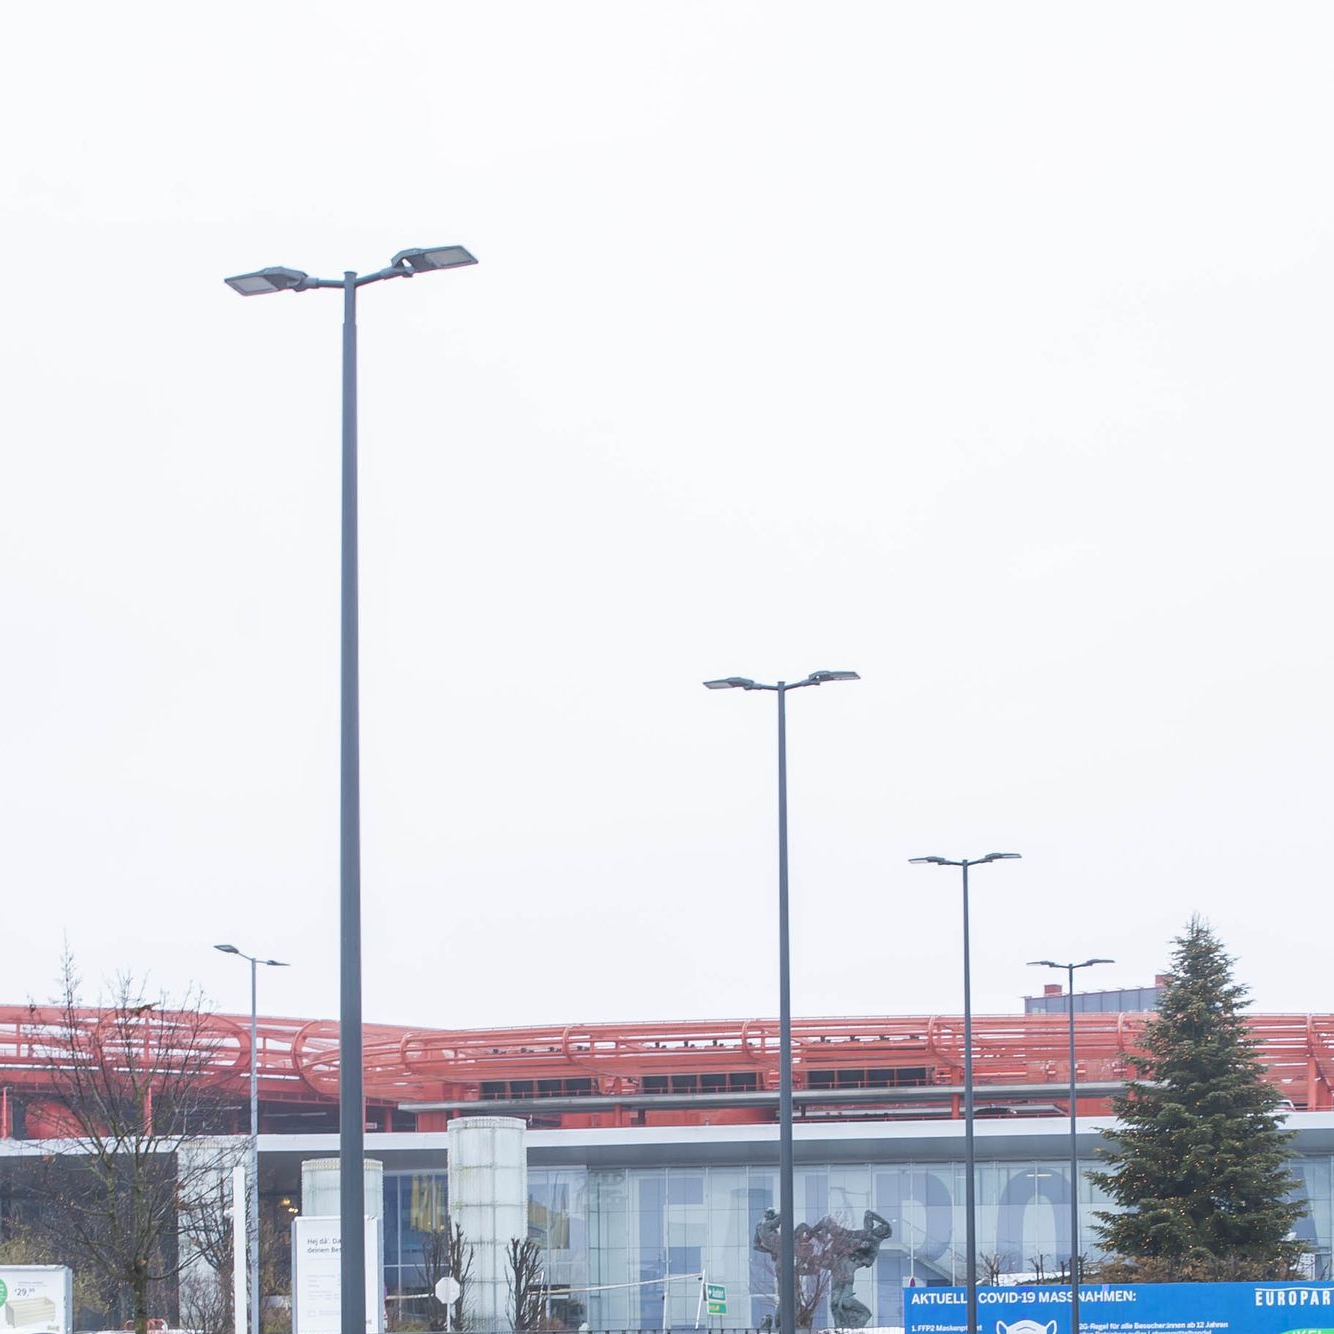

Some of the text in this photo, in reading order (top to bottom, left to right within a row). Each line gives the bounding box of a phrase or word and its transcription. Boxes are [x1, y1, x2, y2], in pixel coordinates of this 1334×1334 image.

[911, 1290, 1137, 1305] AKTUELL COVID-19 MASSNAHMEN:
